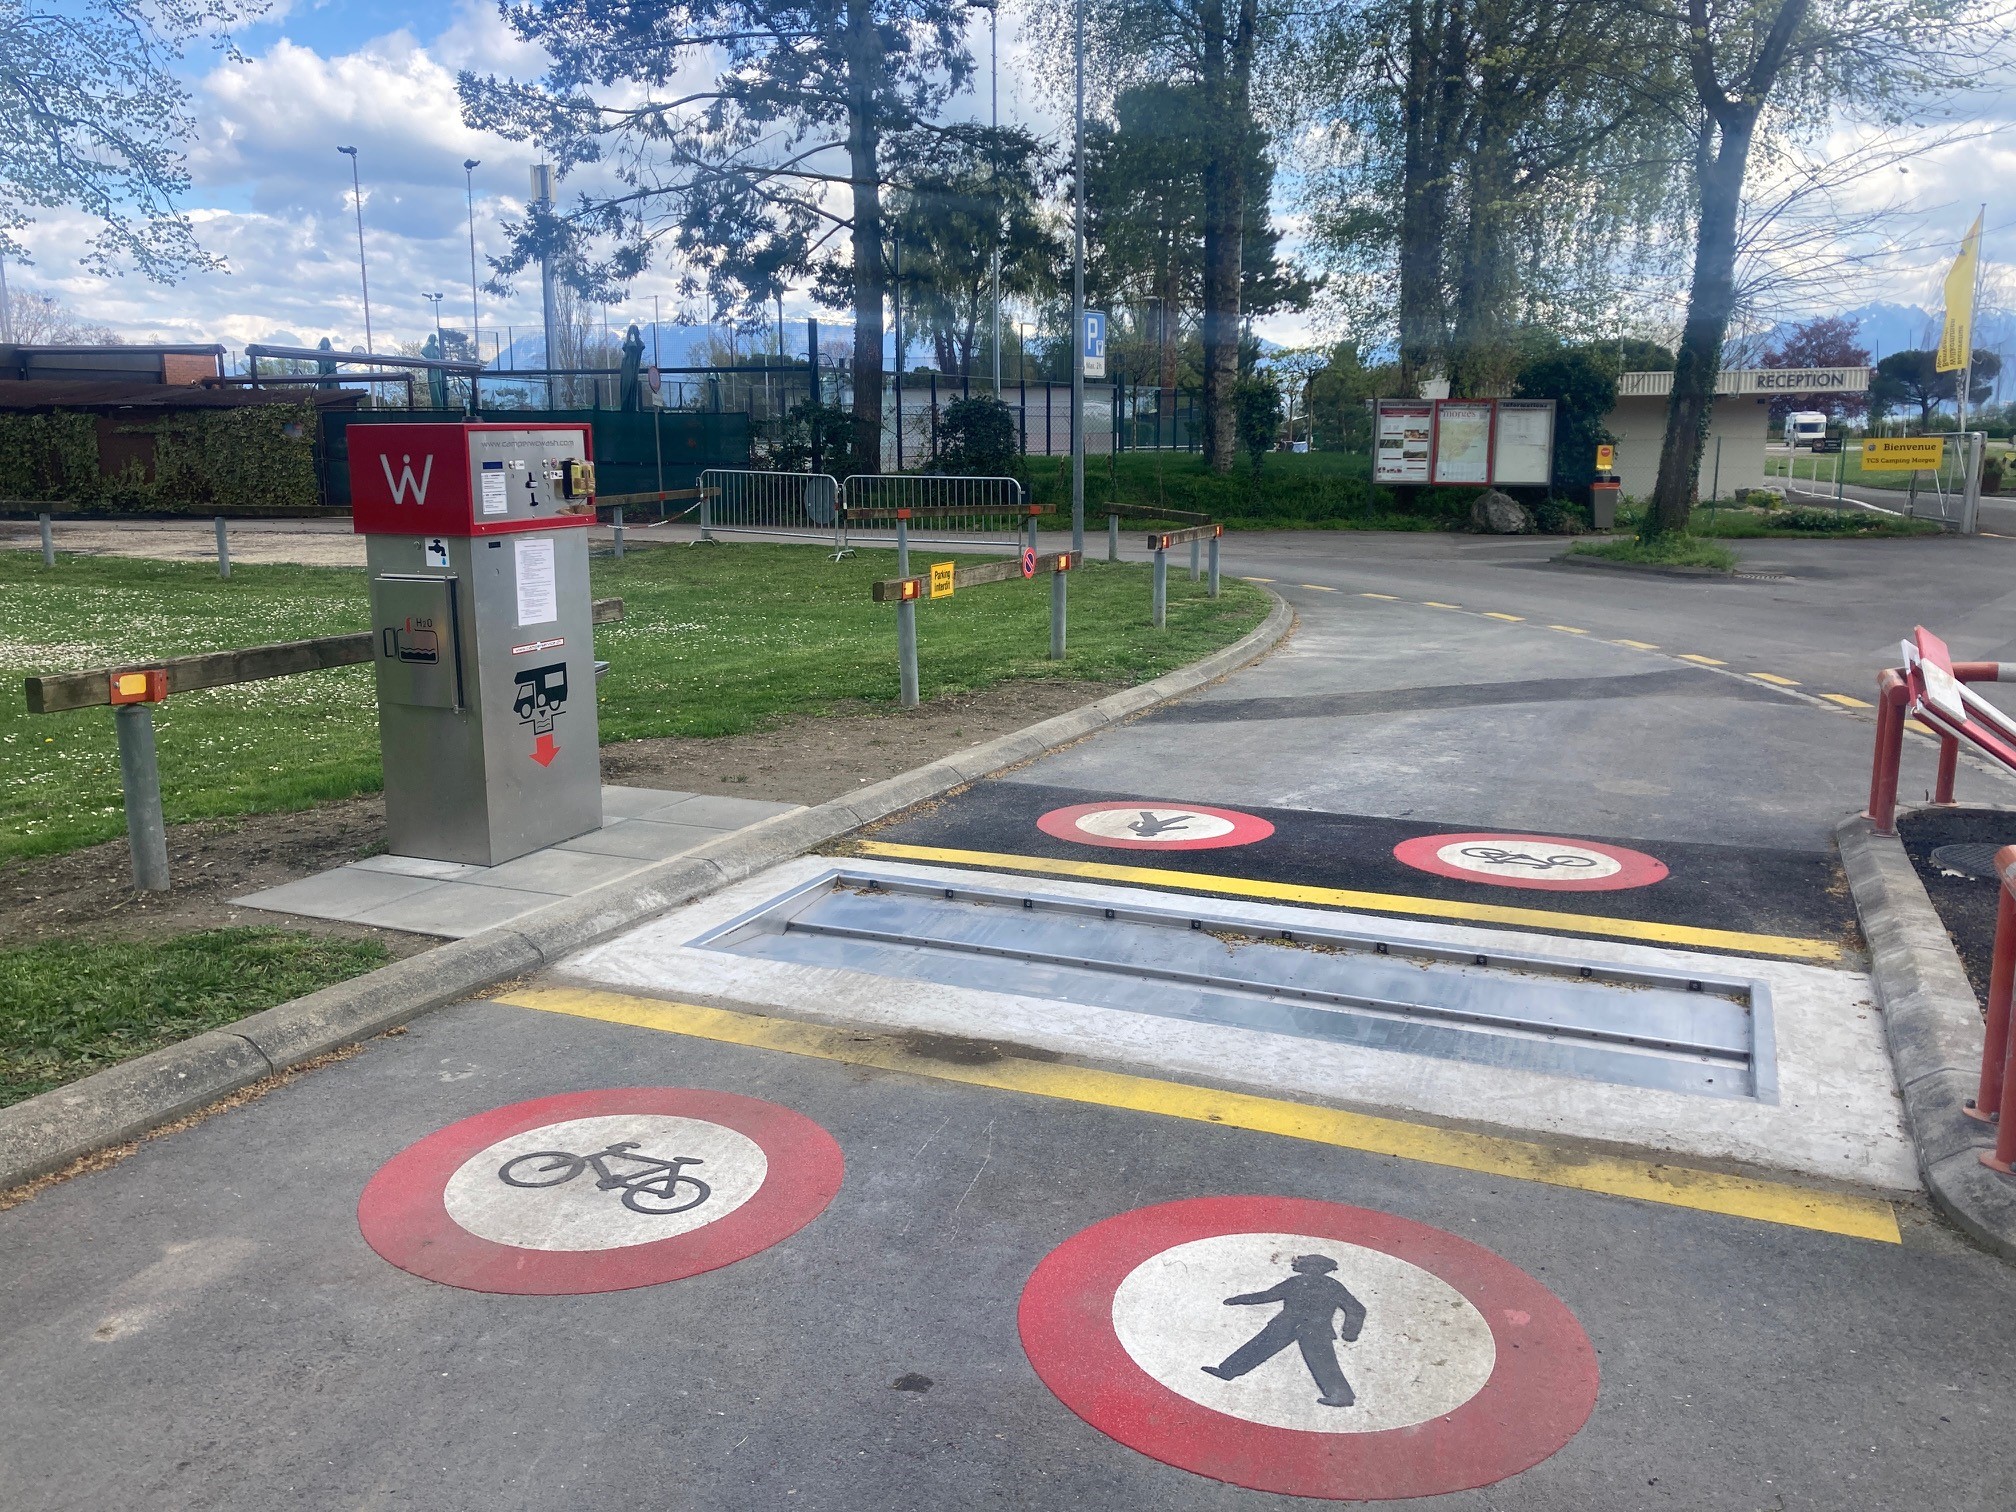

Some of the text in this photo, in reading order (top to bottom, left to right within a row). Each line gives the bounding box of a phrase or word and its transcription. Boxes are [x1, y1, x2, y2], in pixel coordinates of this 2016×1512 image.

[1087, 317, 1098, 350] P
[1757, 373, 1844, 388] RECEPTION
[1883, 443, 1937, 451] Bienvenue
[1880, 457, 1910, 465] Camping
[934, 570, 951, 580] Parking
[415, 618, 433, 628] H2O
